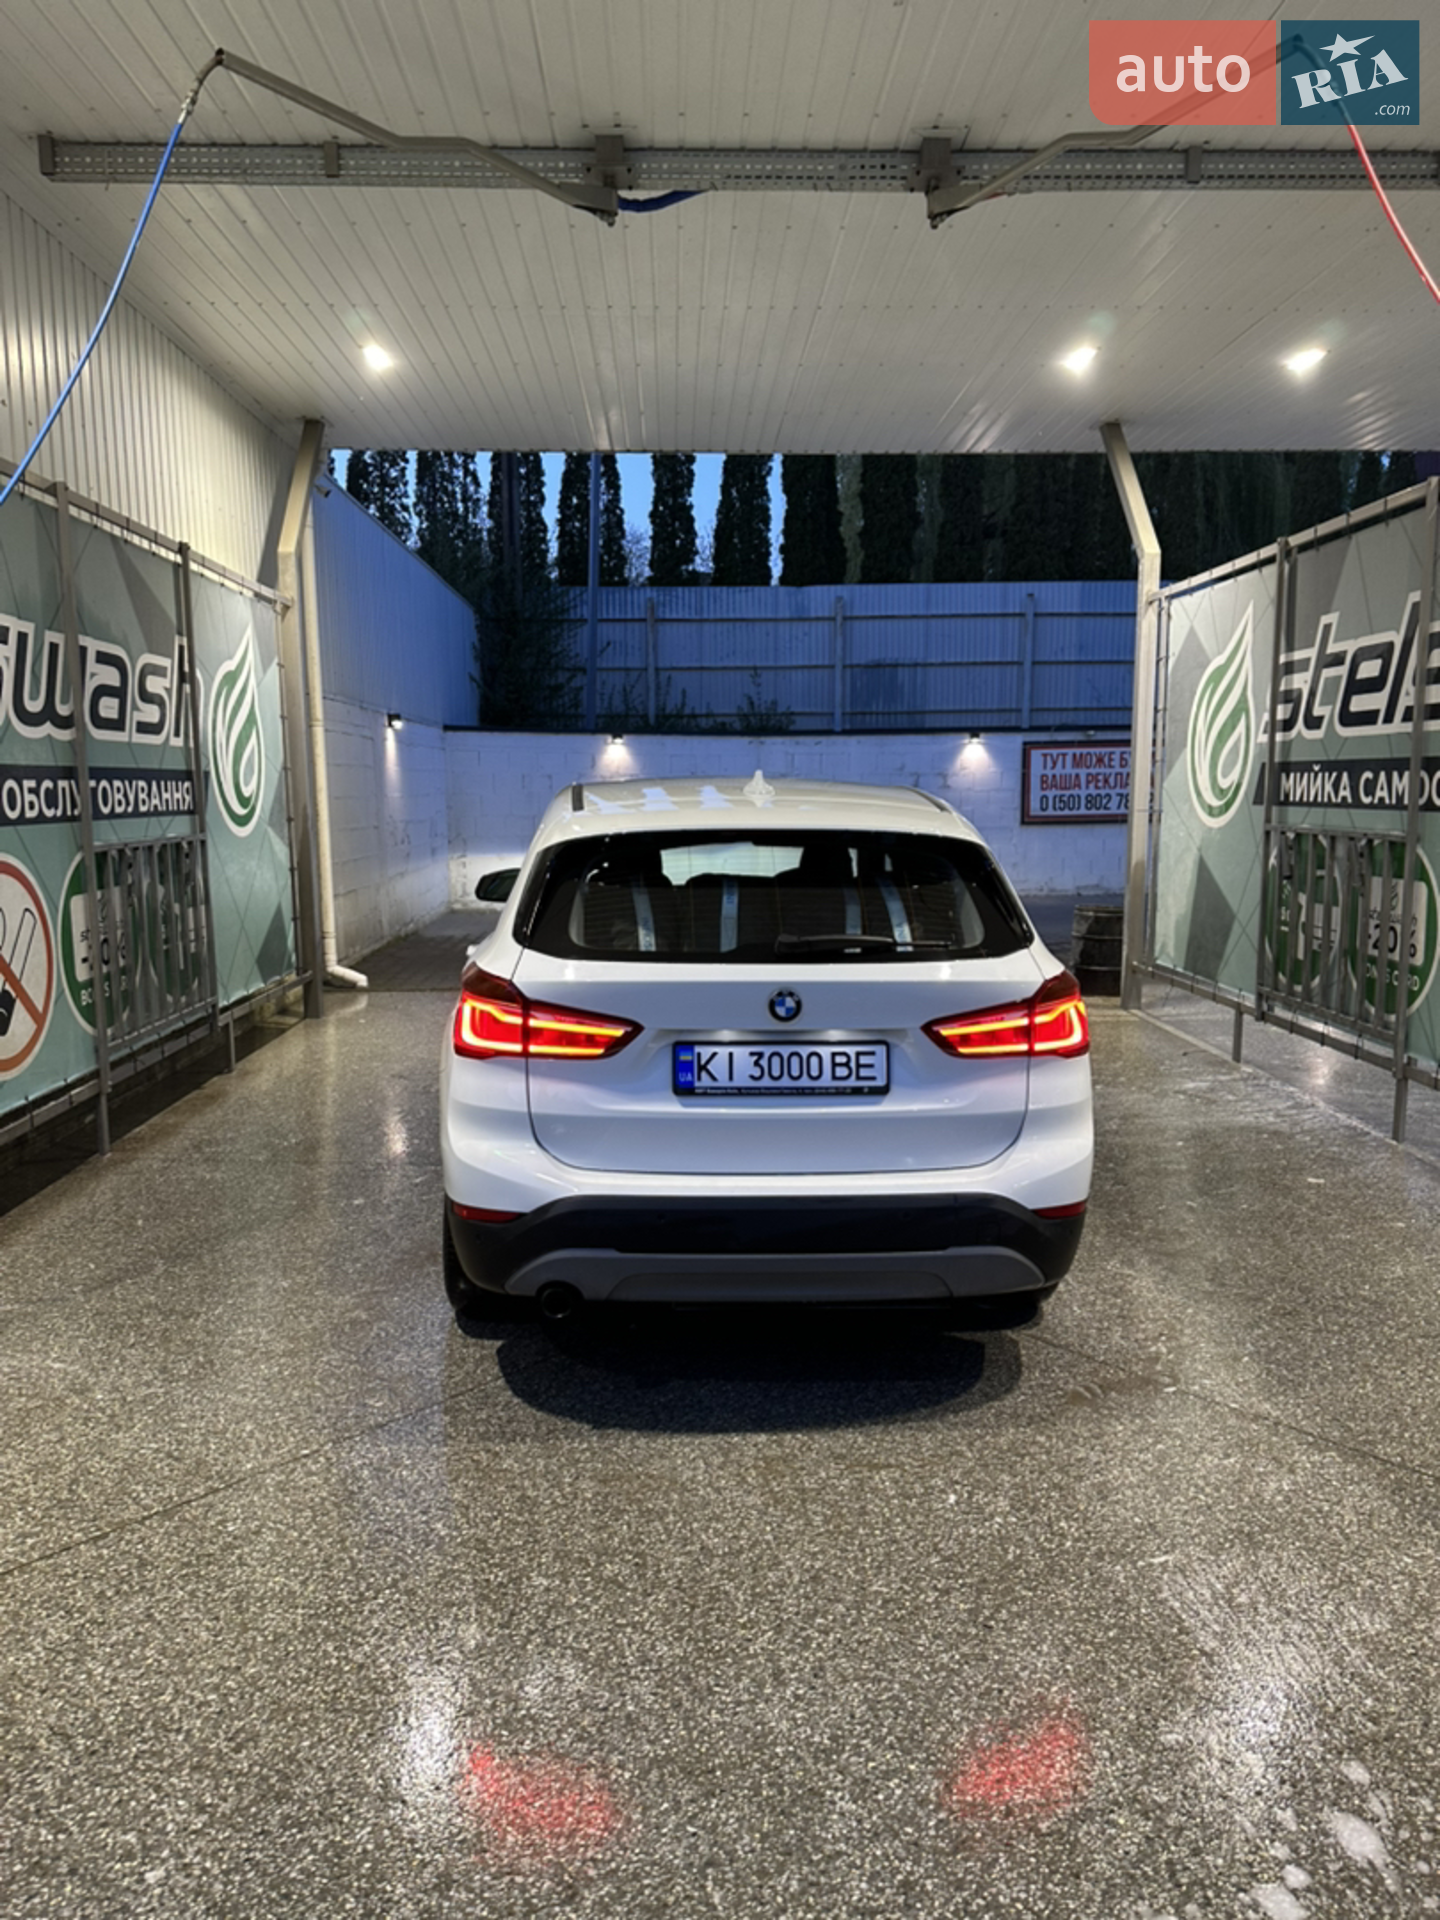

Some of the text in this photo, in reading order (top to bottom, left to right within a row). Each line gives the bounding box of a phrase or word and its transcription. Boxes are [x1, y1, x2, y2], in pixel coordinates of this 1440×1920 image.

[1041, 753, 1068, 770] ТУТ
[1072, 751, 1115, 769] МОЖЕ
[1041, 773, 1081, 791] ВАША
[1279, 764, 1351, 804] МИЙКА
[1040, 794, 1049, 812] 0
[1052, 793, 1081, 812] (50)
[1085, 793, 1112, 811] 802
[696, 1051, 733, 1082] KI
[679, 1073, 693, 1082] UA
